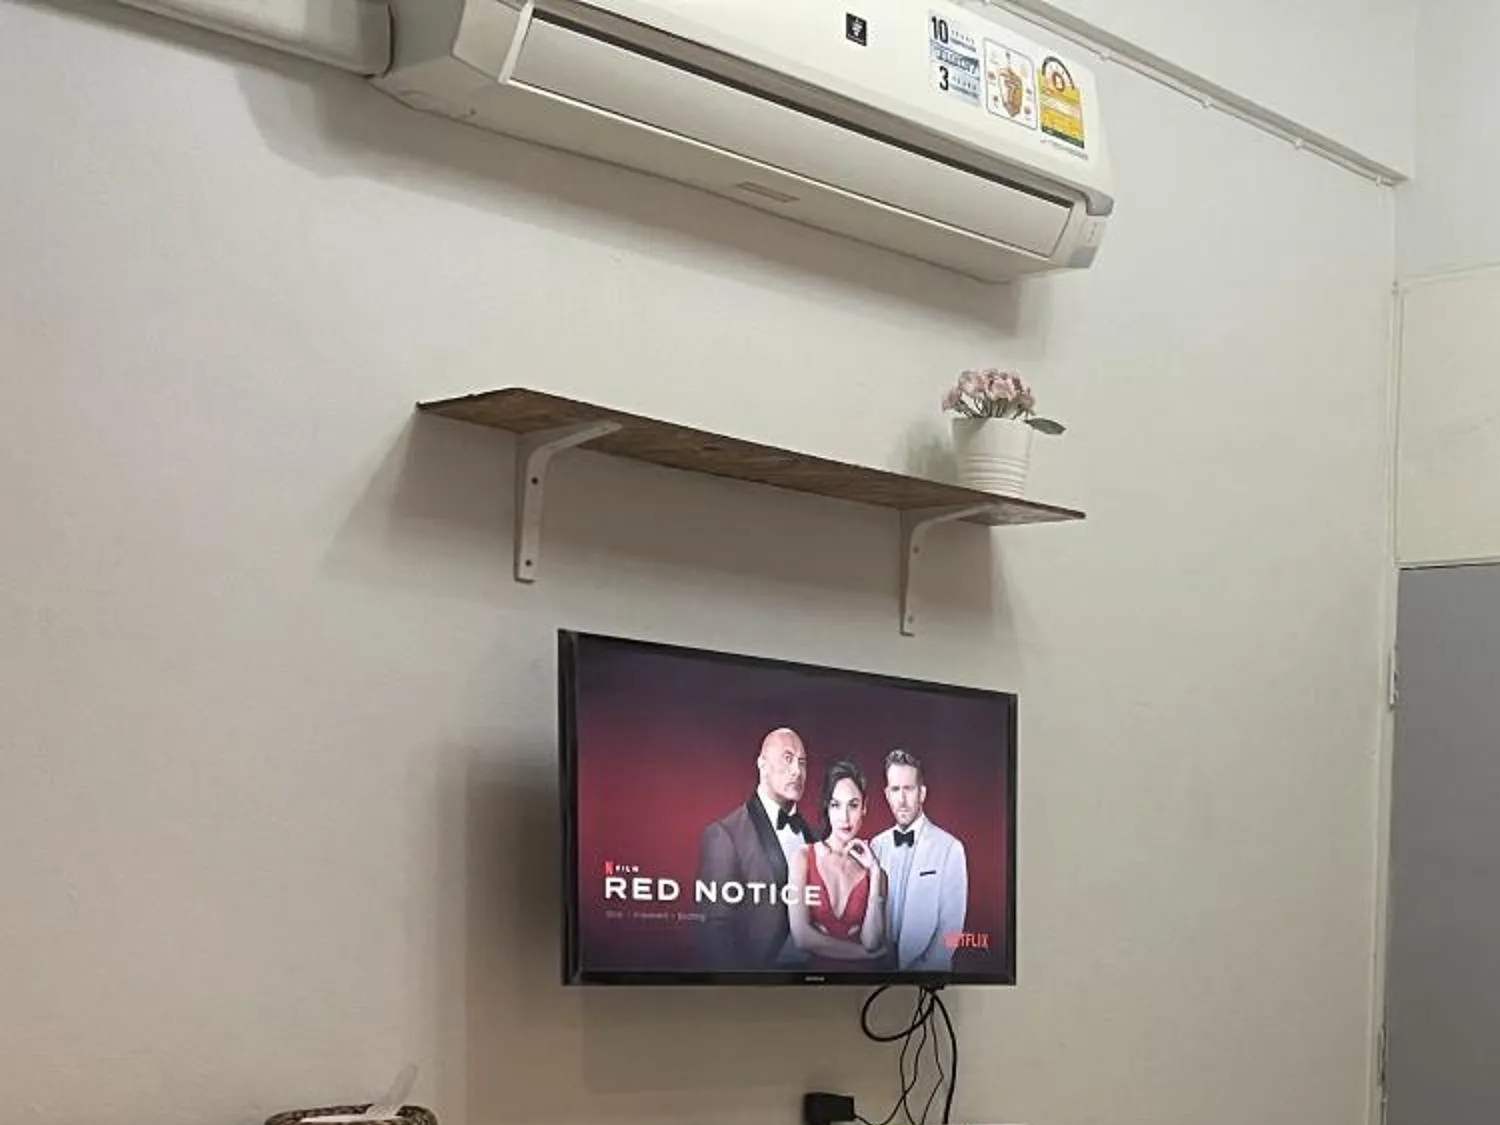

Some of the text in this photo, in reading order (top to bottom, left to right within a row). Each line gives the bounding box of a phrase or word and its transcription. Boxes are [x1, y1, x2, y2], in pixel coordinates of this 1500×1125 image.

[931, 16, 949, 44] 10
[939, 65, 949, 91] 3
[605, 877, 822, 906] RED NOTICE
